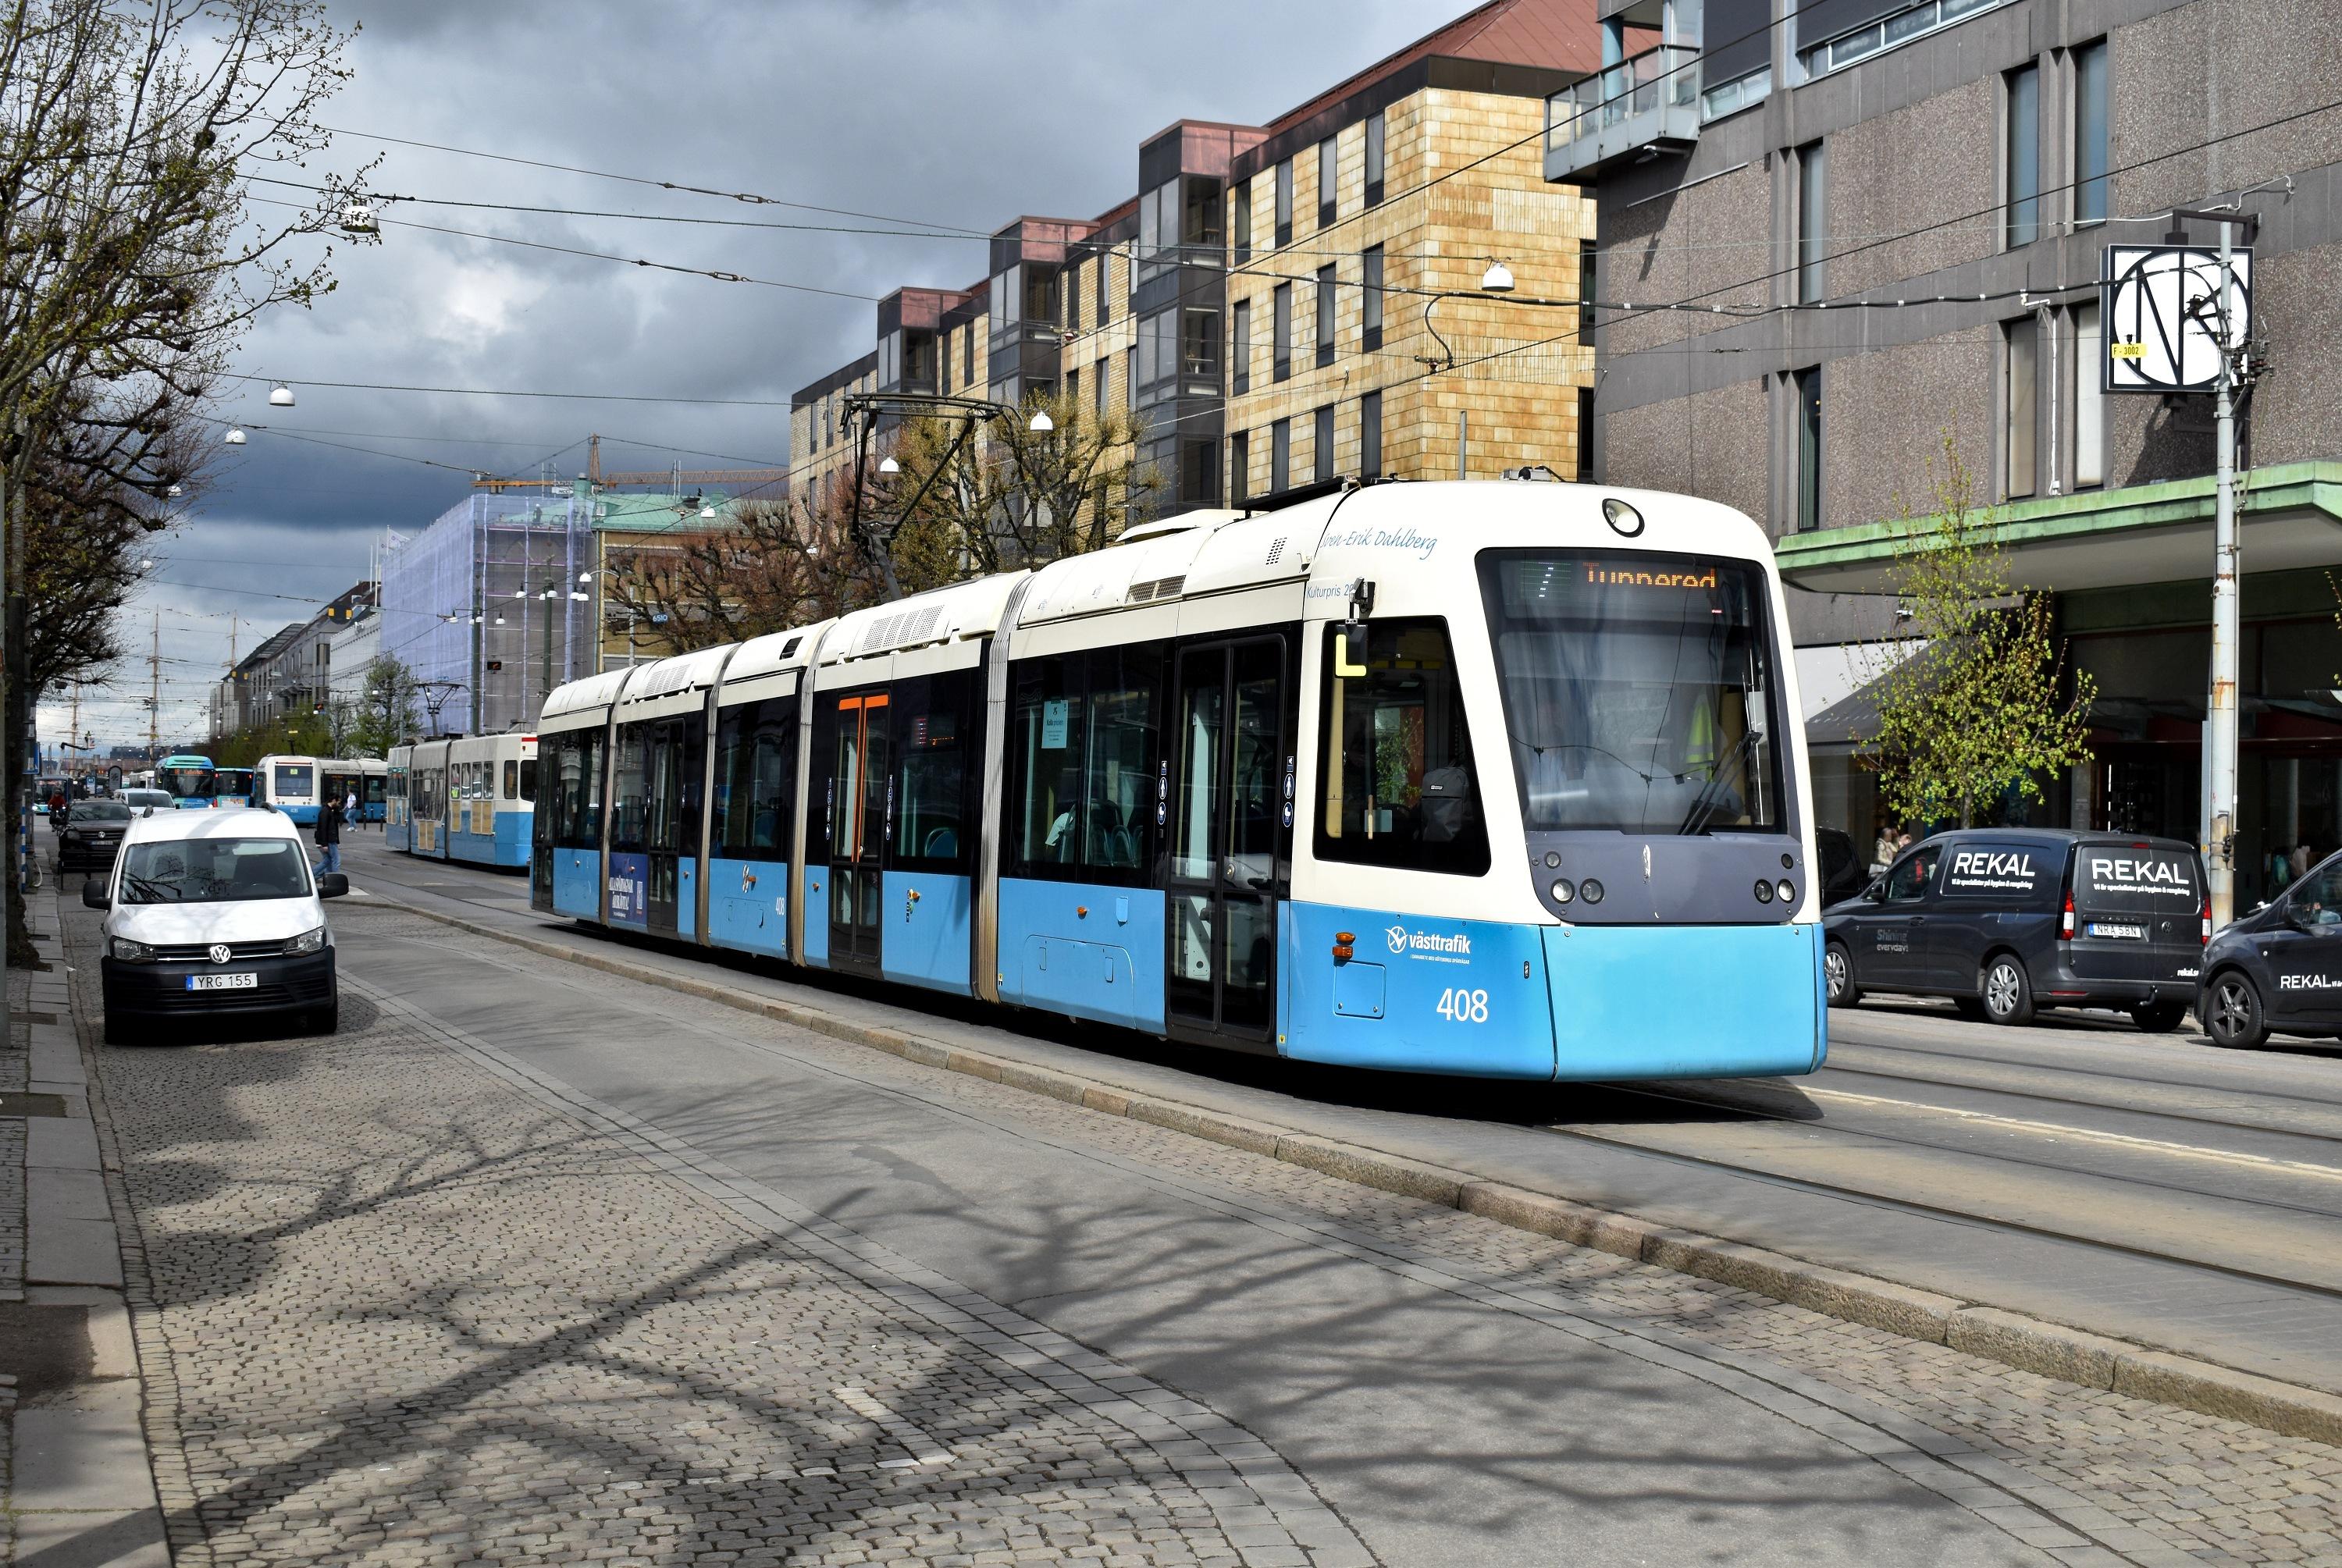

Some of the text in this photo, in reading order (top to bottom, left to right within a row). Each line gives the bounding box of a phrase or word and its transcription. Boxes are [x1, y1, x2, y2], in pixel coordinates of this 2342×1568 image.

[2123, 347, 2139, 355] 3002
[1374, 527, 1437, 560] Dahlberg
[1306, 584, 1341, 600] Kulturpris
[1953, 852, 2036, 877] REKAL
[2091, 859, 2190, 885] REKAL
[775, 897, 785, 916] 408
[1877, 929, 1908, 943] Shining
[2097, 924, 2137, 937] NRA 58N
[1409, 931, 1471, 955] västtrafik
[1877, 943, 1909, 955] everyday!
[198, 975, 251, 988] YRG 155
[2280, 975, 2331, 989] REKAL
[1436, 987, 1489, 1023] 408
